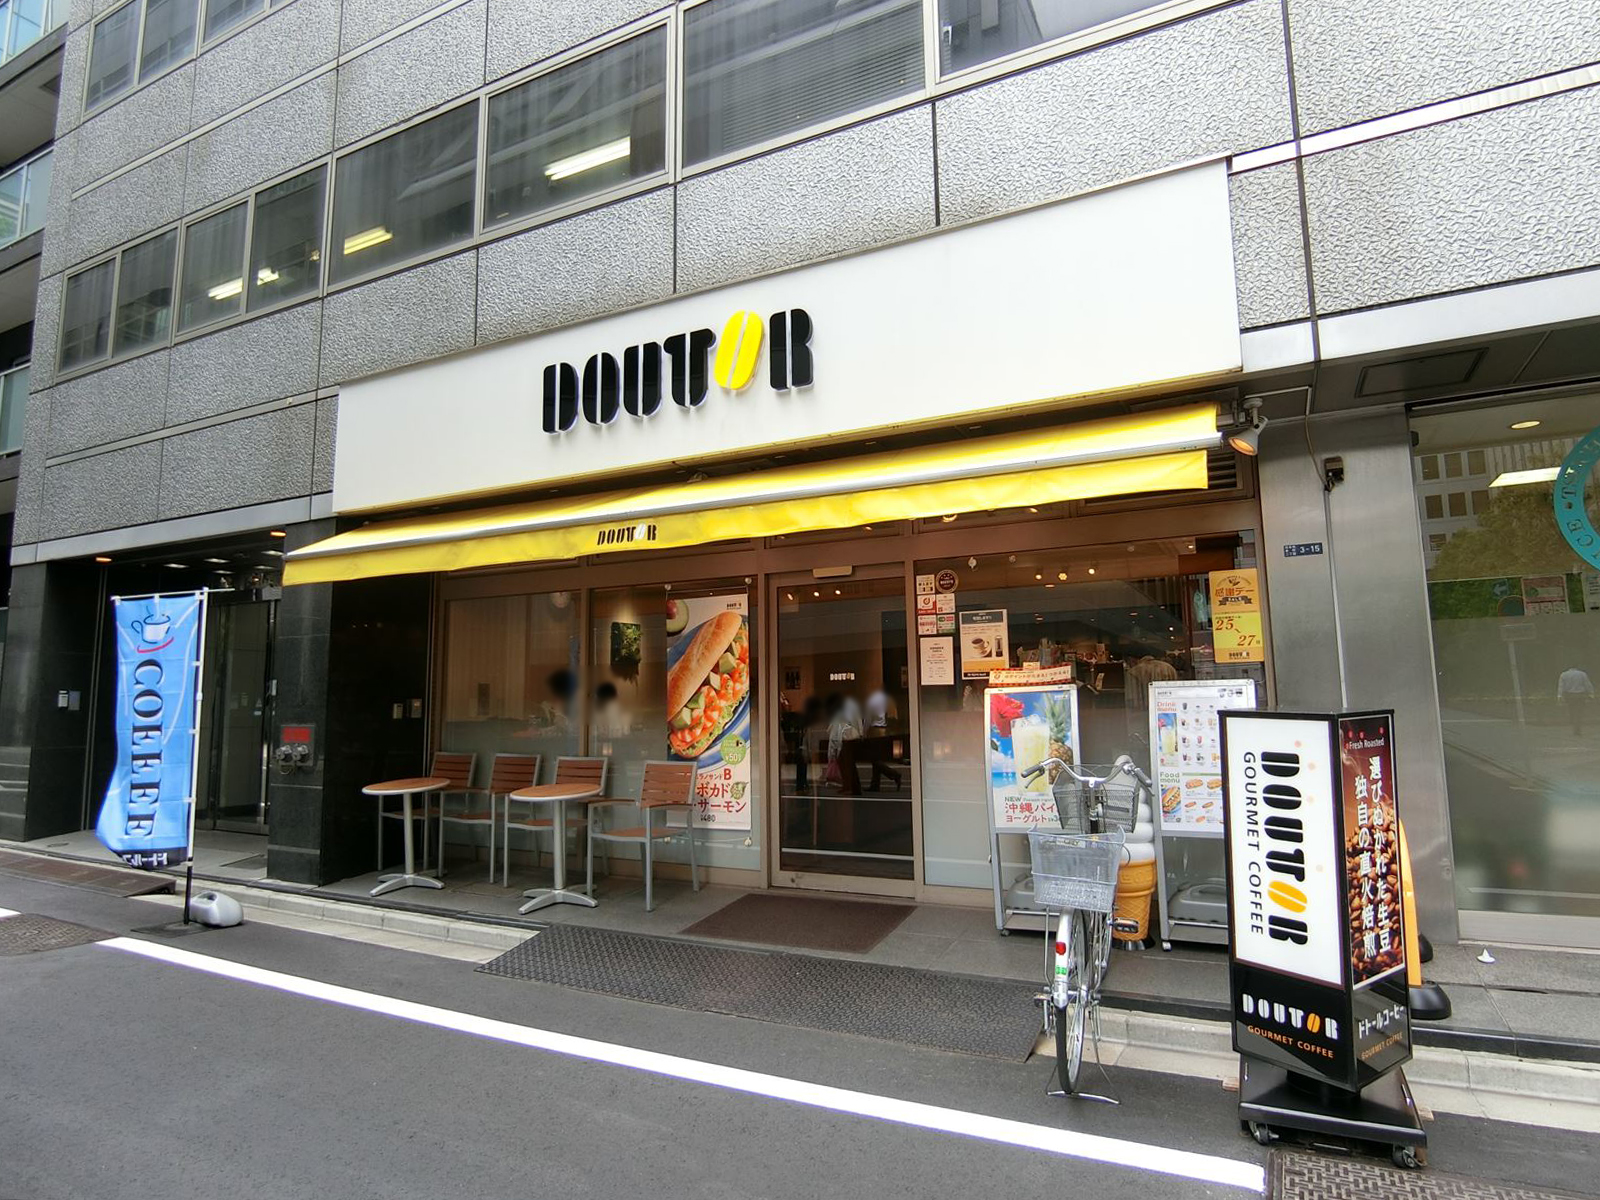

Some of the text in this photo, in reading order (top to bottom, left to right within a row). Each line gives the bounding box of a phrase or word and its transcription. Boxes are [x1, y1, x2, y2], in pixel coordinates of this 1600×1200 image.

[542, 308, 814, 434] DOUTOR
[597, 524, 657, 546] DOUTOR
[1350, 737, 1385, 750] Fresh Roasted
[1243, 751, 1263, 935] GOURMET COFFEE
[1261, 751, 1309, 946] DOUTOR
[1242, 993, 1338, 1040] DOUTOR
[1358, 1004, 1405, 1039] ドトールコーヒー
[1247, 1025, 1334, 1059] GOURMET COFFEE
